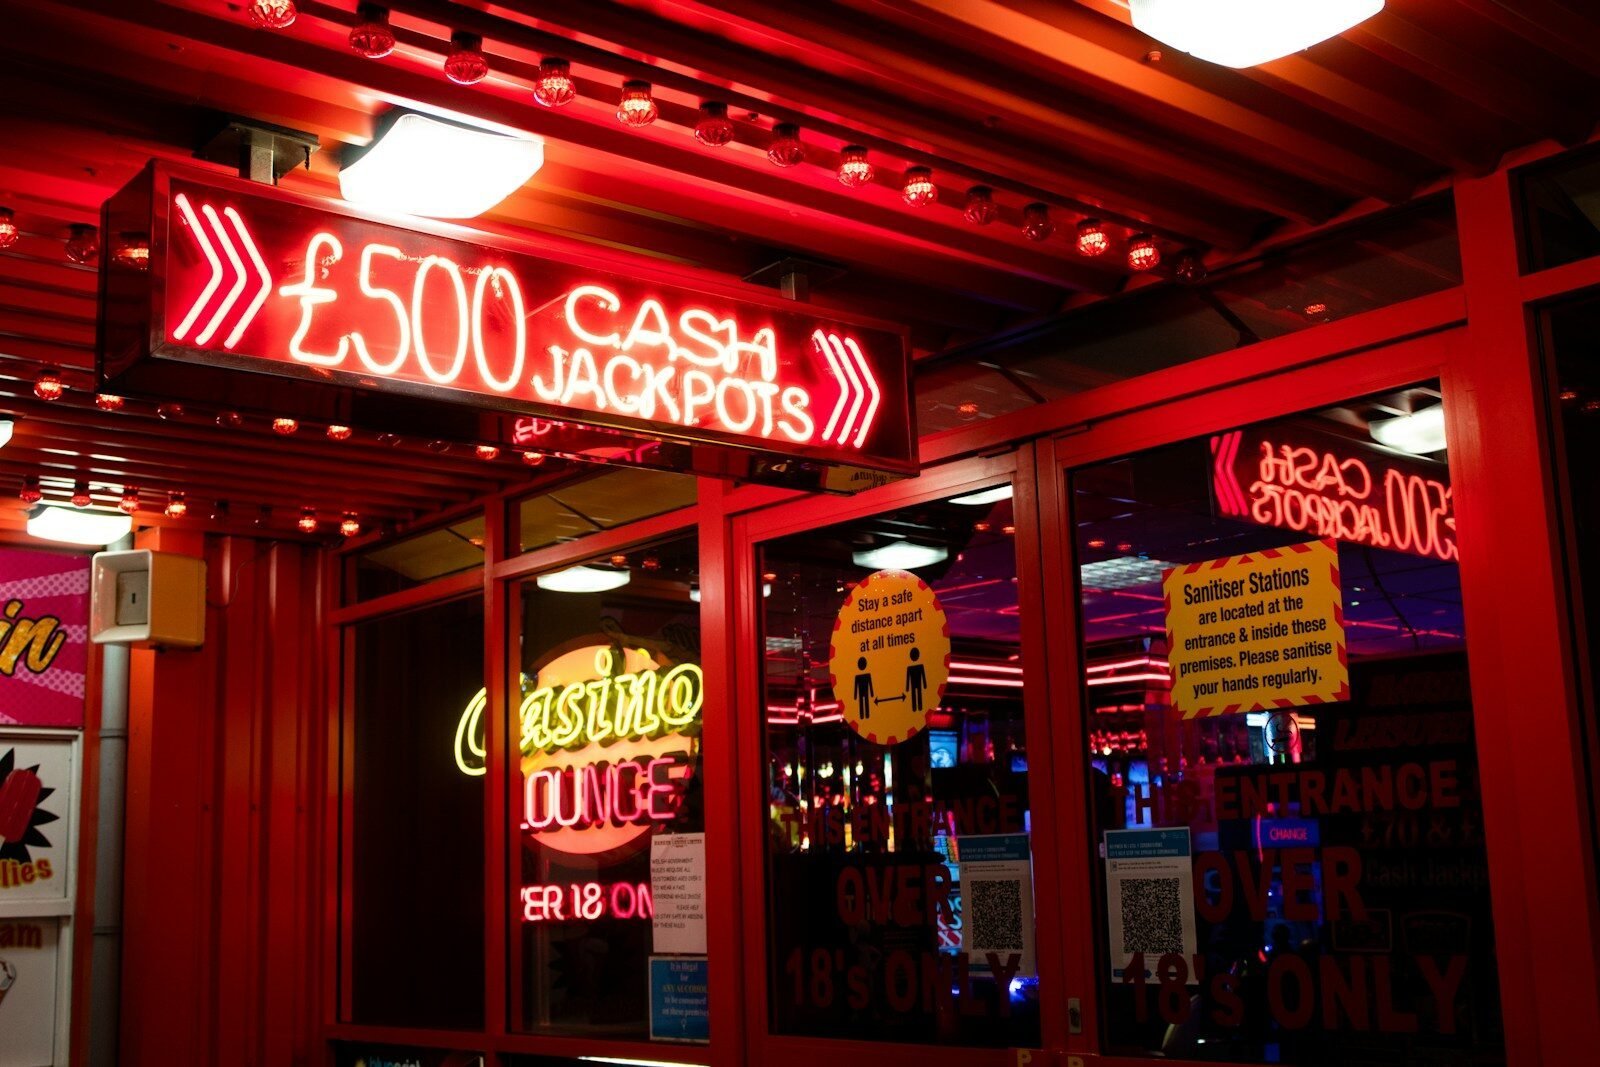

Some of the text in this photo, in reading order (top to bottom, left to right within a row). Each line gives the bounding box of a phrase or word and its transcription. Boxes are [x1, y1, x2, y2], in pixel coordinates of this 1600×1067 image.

[279, 232, 526, 392] £500
[564, 284, 778, 382] CASH
[534, 344, 815, 442] JACKPOTS
[858, 589, 913, 614] Stay a safe
[1184, 567, 1309, 606] Sanitiser Stations
[851, 608, 923, 634] distance apart
[1198, 596, 1303, 625] are located at the
[860, 632, 915, 652] at all times
[1185, 617, 1326, 651] entrance & inside these
[1180, 641, 1332, 677] premises. Please sanitise
[1193, 666, 1322, 699] your hands regularly.
[454, 647, 704, 777] Casino
[520, 757, 676, 830] OUNGE
[1216, 760, 1460, 820] ENTRANCE
[854, 794, 1019, 843] ENTRANCE
[1269, 827, 1309, 841] CHANGE
[0, 858, 53, 888] lies
[1196, 844, 1369, 925] OVER
[570, 882, 602, 921] 18
[834, 863, 951, 927] OVER
[0, 923, 43, 949] am
[785, 946, 1021, 1019] 18's ONLY
[1120, 950, 1471, 1035] 18's ONLY
